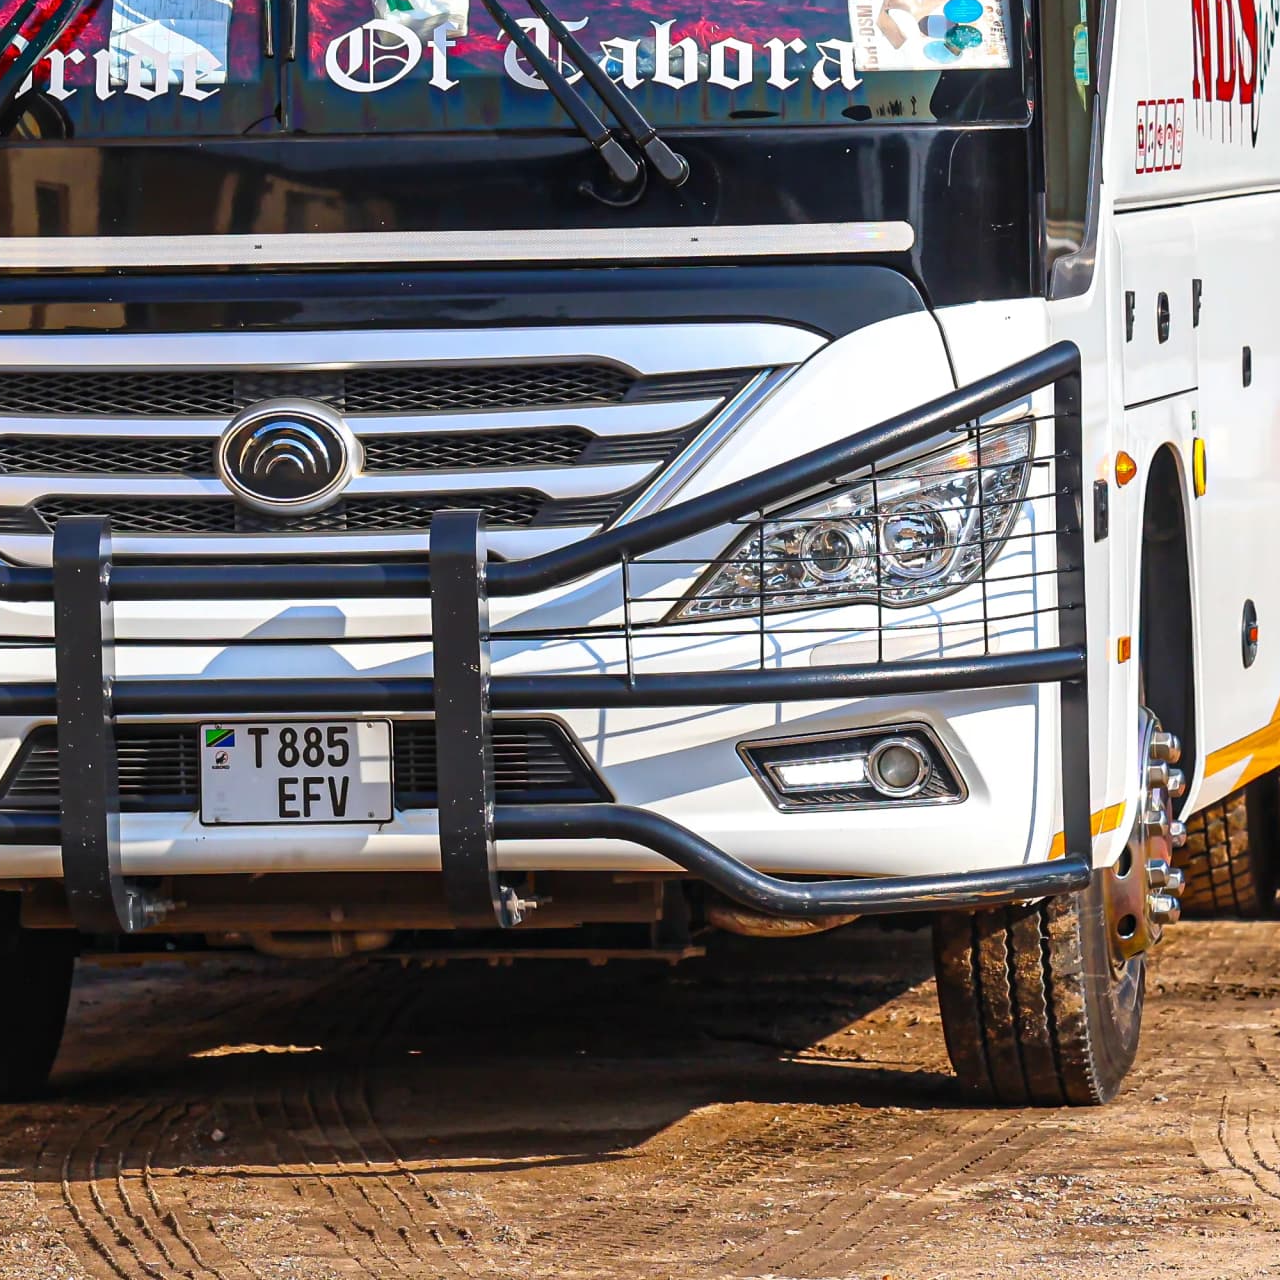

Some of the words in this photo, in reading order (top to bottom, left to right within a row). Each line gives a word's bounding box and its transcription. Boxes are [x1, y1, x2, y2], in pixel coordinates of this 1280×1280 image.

[325, 19, 460, 93] Of
[247, 727, 269, 768] T
[277, 726, 349, 768] 885
[278, 776, 349, 818] EFV
